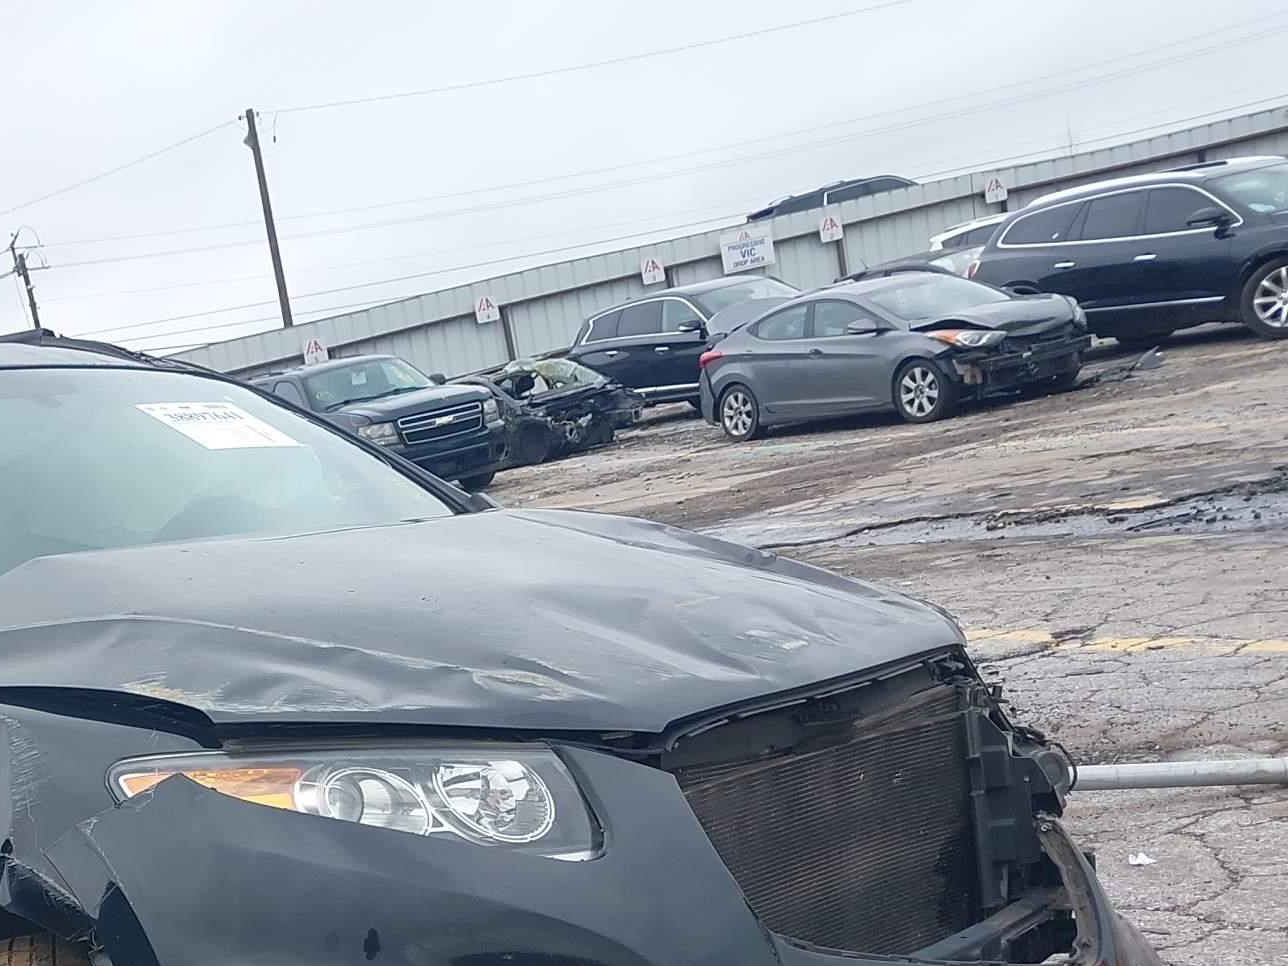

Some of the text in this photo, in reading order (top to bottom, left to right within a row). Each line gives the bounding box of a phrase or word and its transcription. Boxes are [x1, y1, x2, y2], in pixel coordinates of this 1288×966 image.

[727, 239, 765, 252] PROGRESSIVE
[740, 247, 756, 259] VIC
[733, 255, 765, 268] DROP AREA
